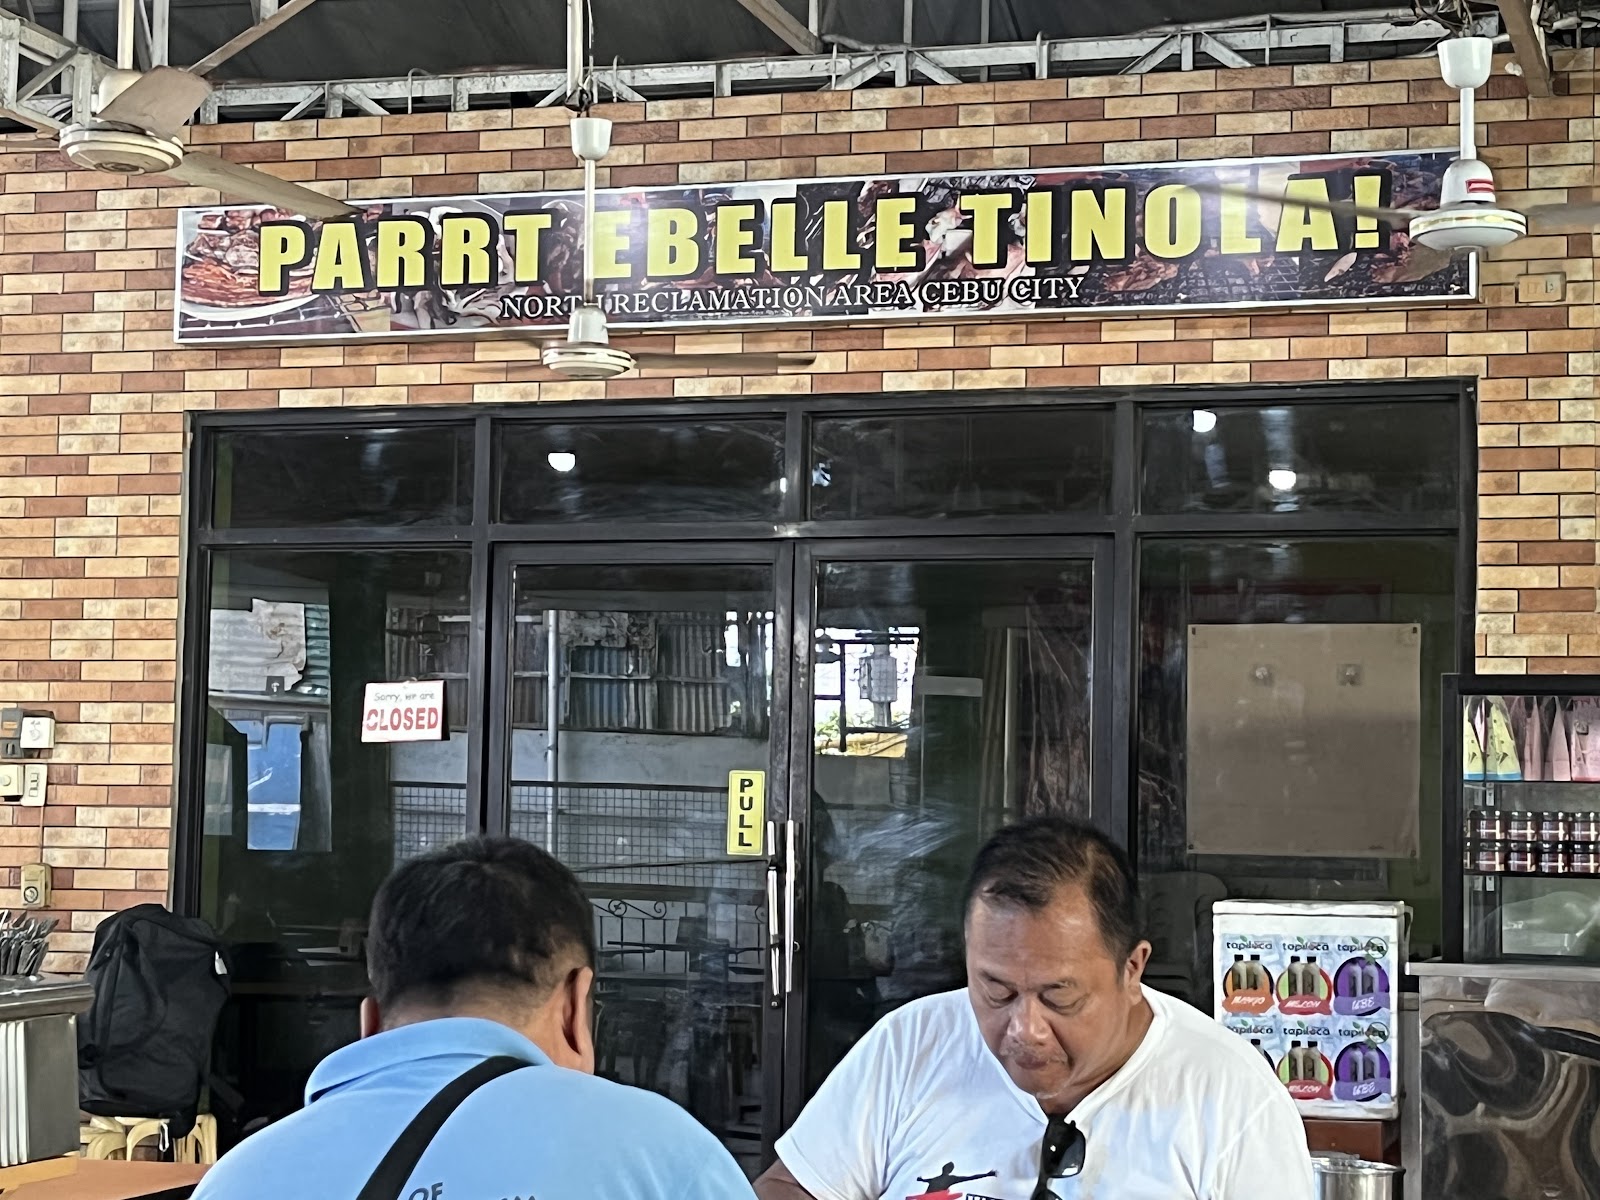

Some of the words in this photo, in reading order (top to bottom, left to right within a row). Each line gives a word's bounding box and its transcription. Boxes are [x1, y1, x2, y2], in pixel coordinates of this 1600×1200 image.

[260, 214, 552, 292] PARRT
[594, 198, 917, 278] EBELLE
[960, 175, 1382, 265] TINOLA!
[613, 286, 825, 314] RECLAMATION
[833, 283, 912, 306] AREA
[922, 280, 1001, 304] CEBU
[1012, 277, 1084, 300] CITY
[419, 692, 434, 700] are
[366, 707, 438, 731] CLOSED
[738, 778, 754, 847] PULL
